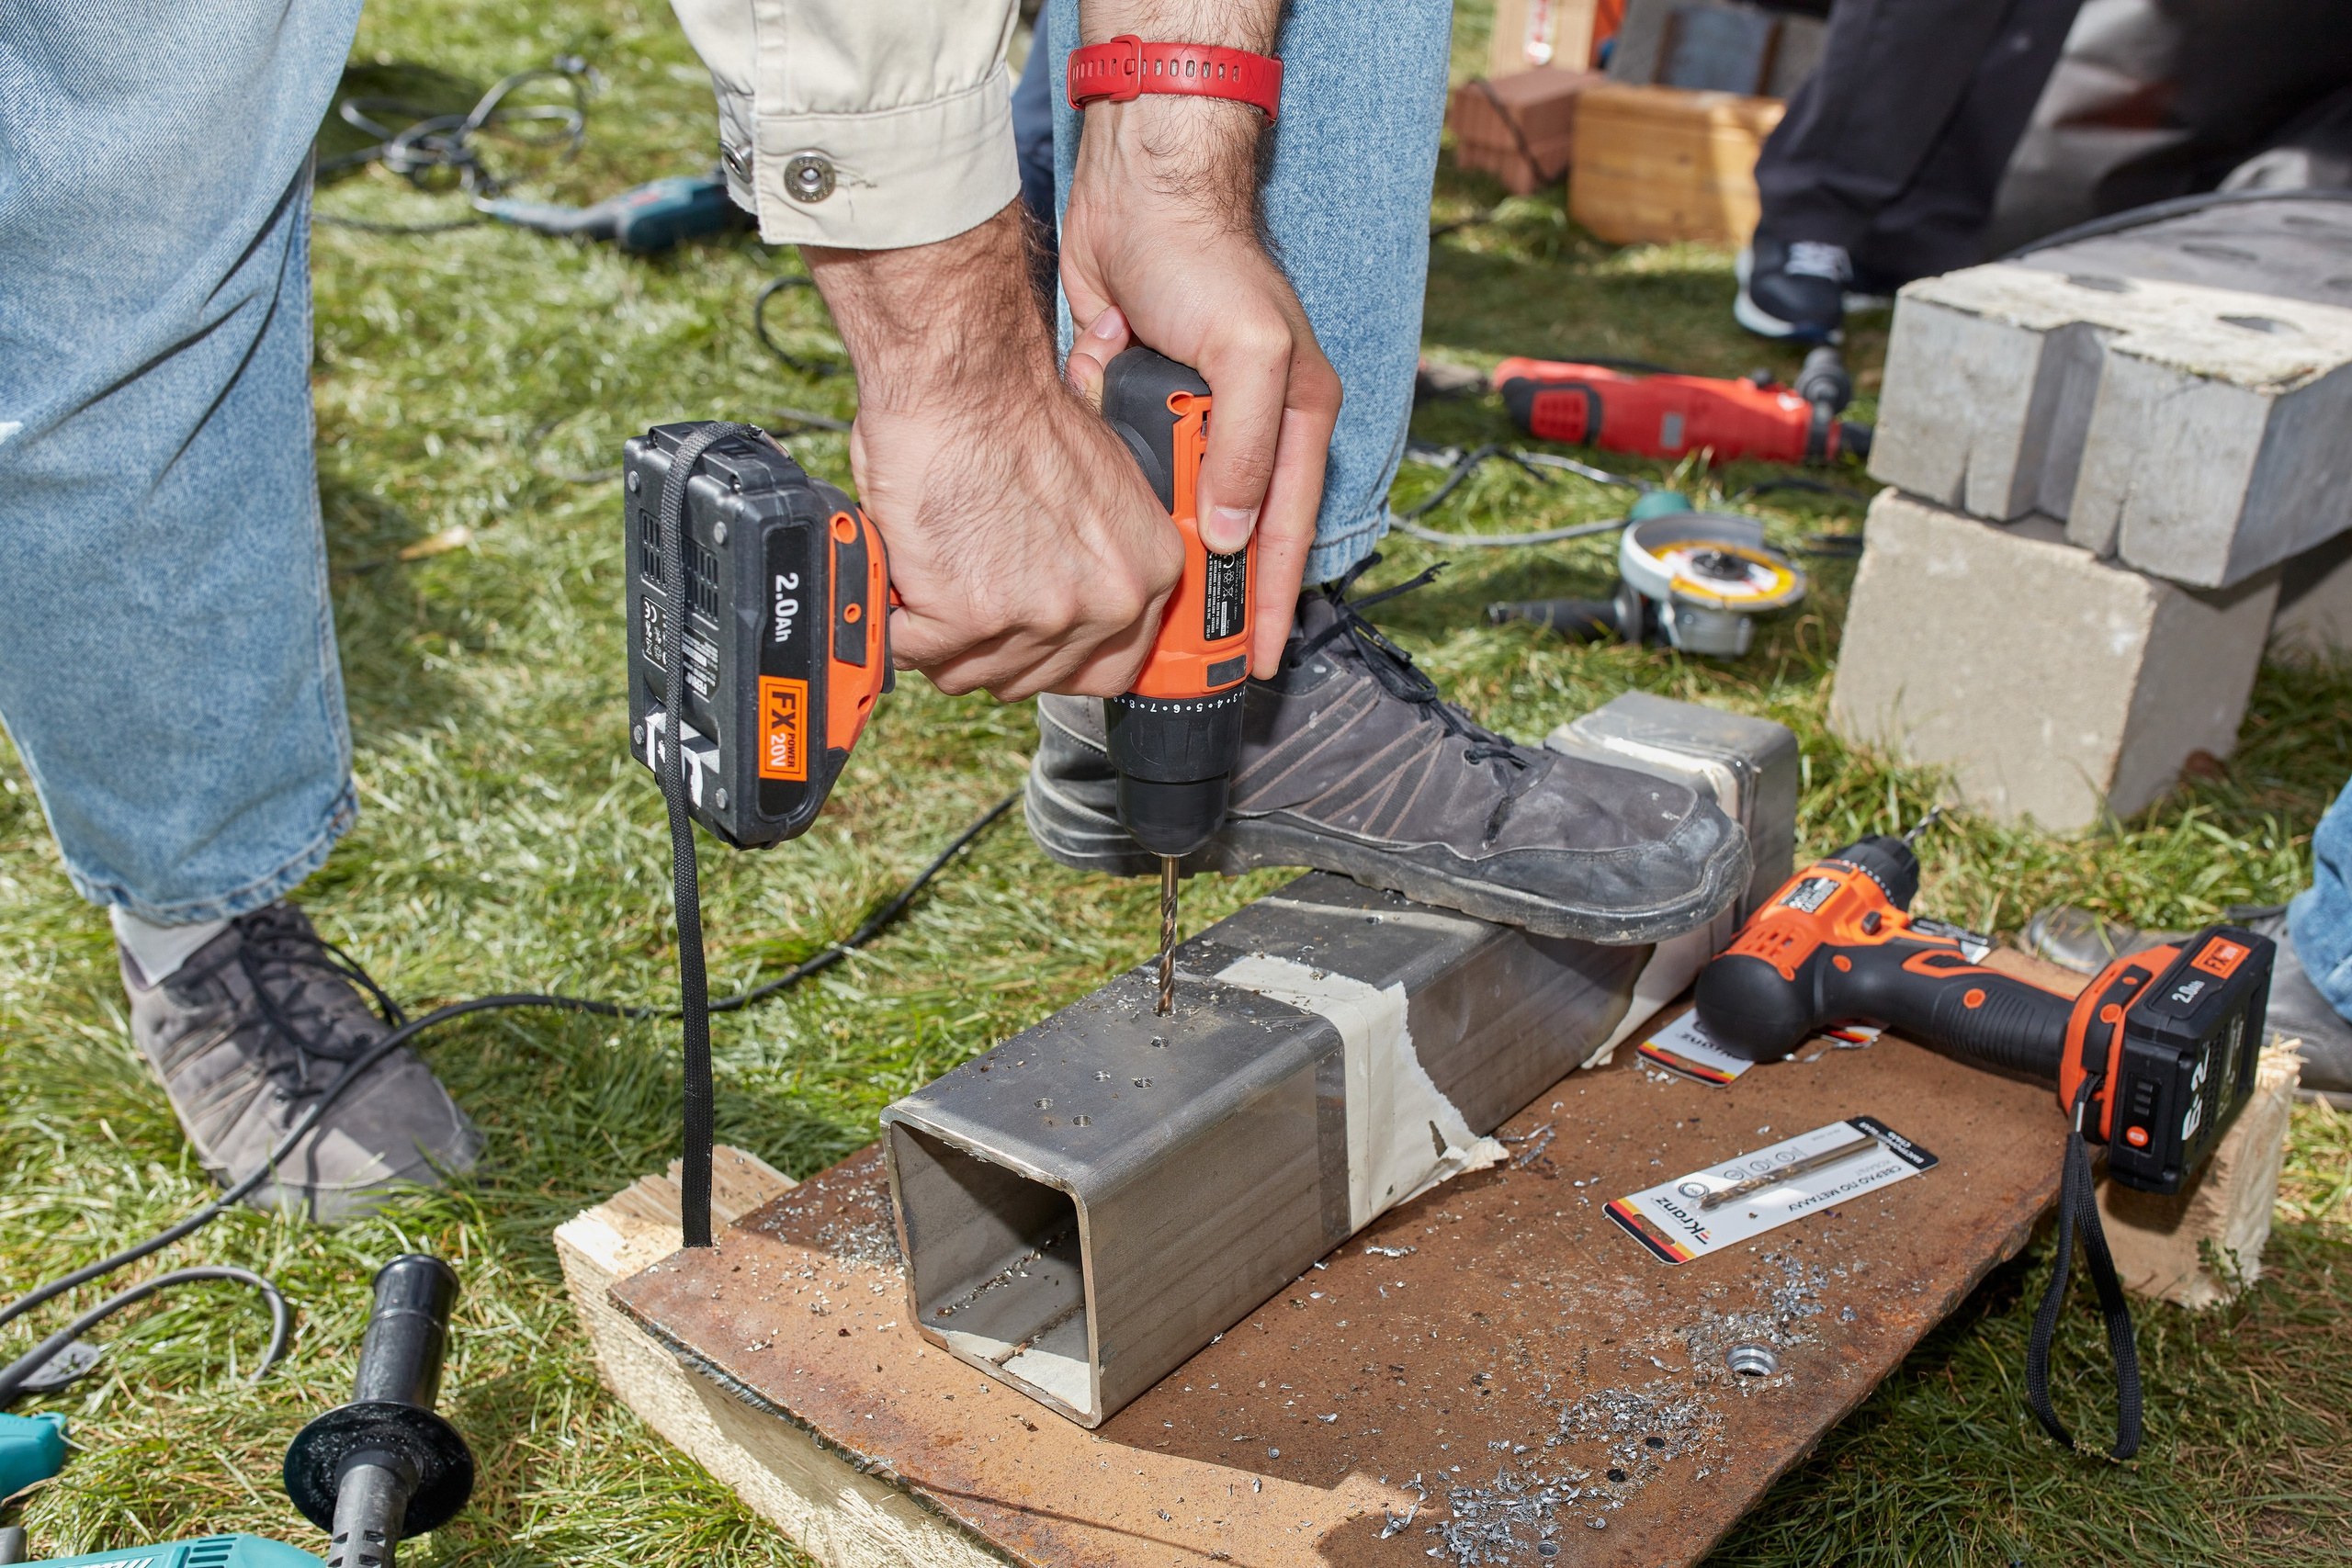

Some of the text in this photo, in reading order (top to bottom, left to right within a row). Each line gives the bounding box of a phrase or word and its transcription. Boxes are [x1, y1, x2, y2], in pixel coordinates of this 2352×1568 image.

[775, 572, 799, 643] 2.0Ah
[1129, 699, 1136, 709] 8
[1150, 703, 1158, 713] 7
[1173, 704, 1181, 714] 6
[1196, 703, 1204, 713] 5
[1217, 699, 1224, 709] 4
[771, 691, 796, 767] FX 20V
[787, 733, 797, 768] POWER
[1839, 1179, 1860, 1192] ПО
[1788, 1188, 1839, 1213] МЕТАЛЛУ
[1656, 1197, 1706, 1235] Kranz
